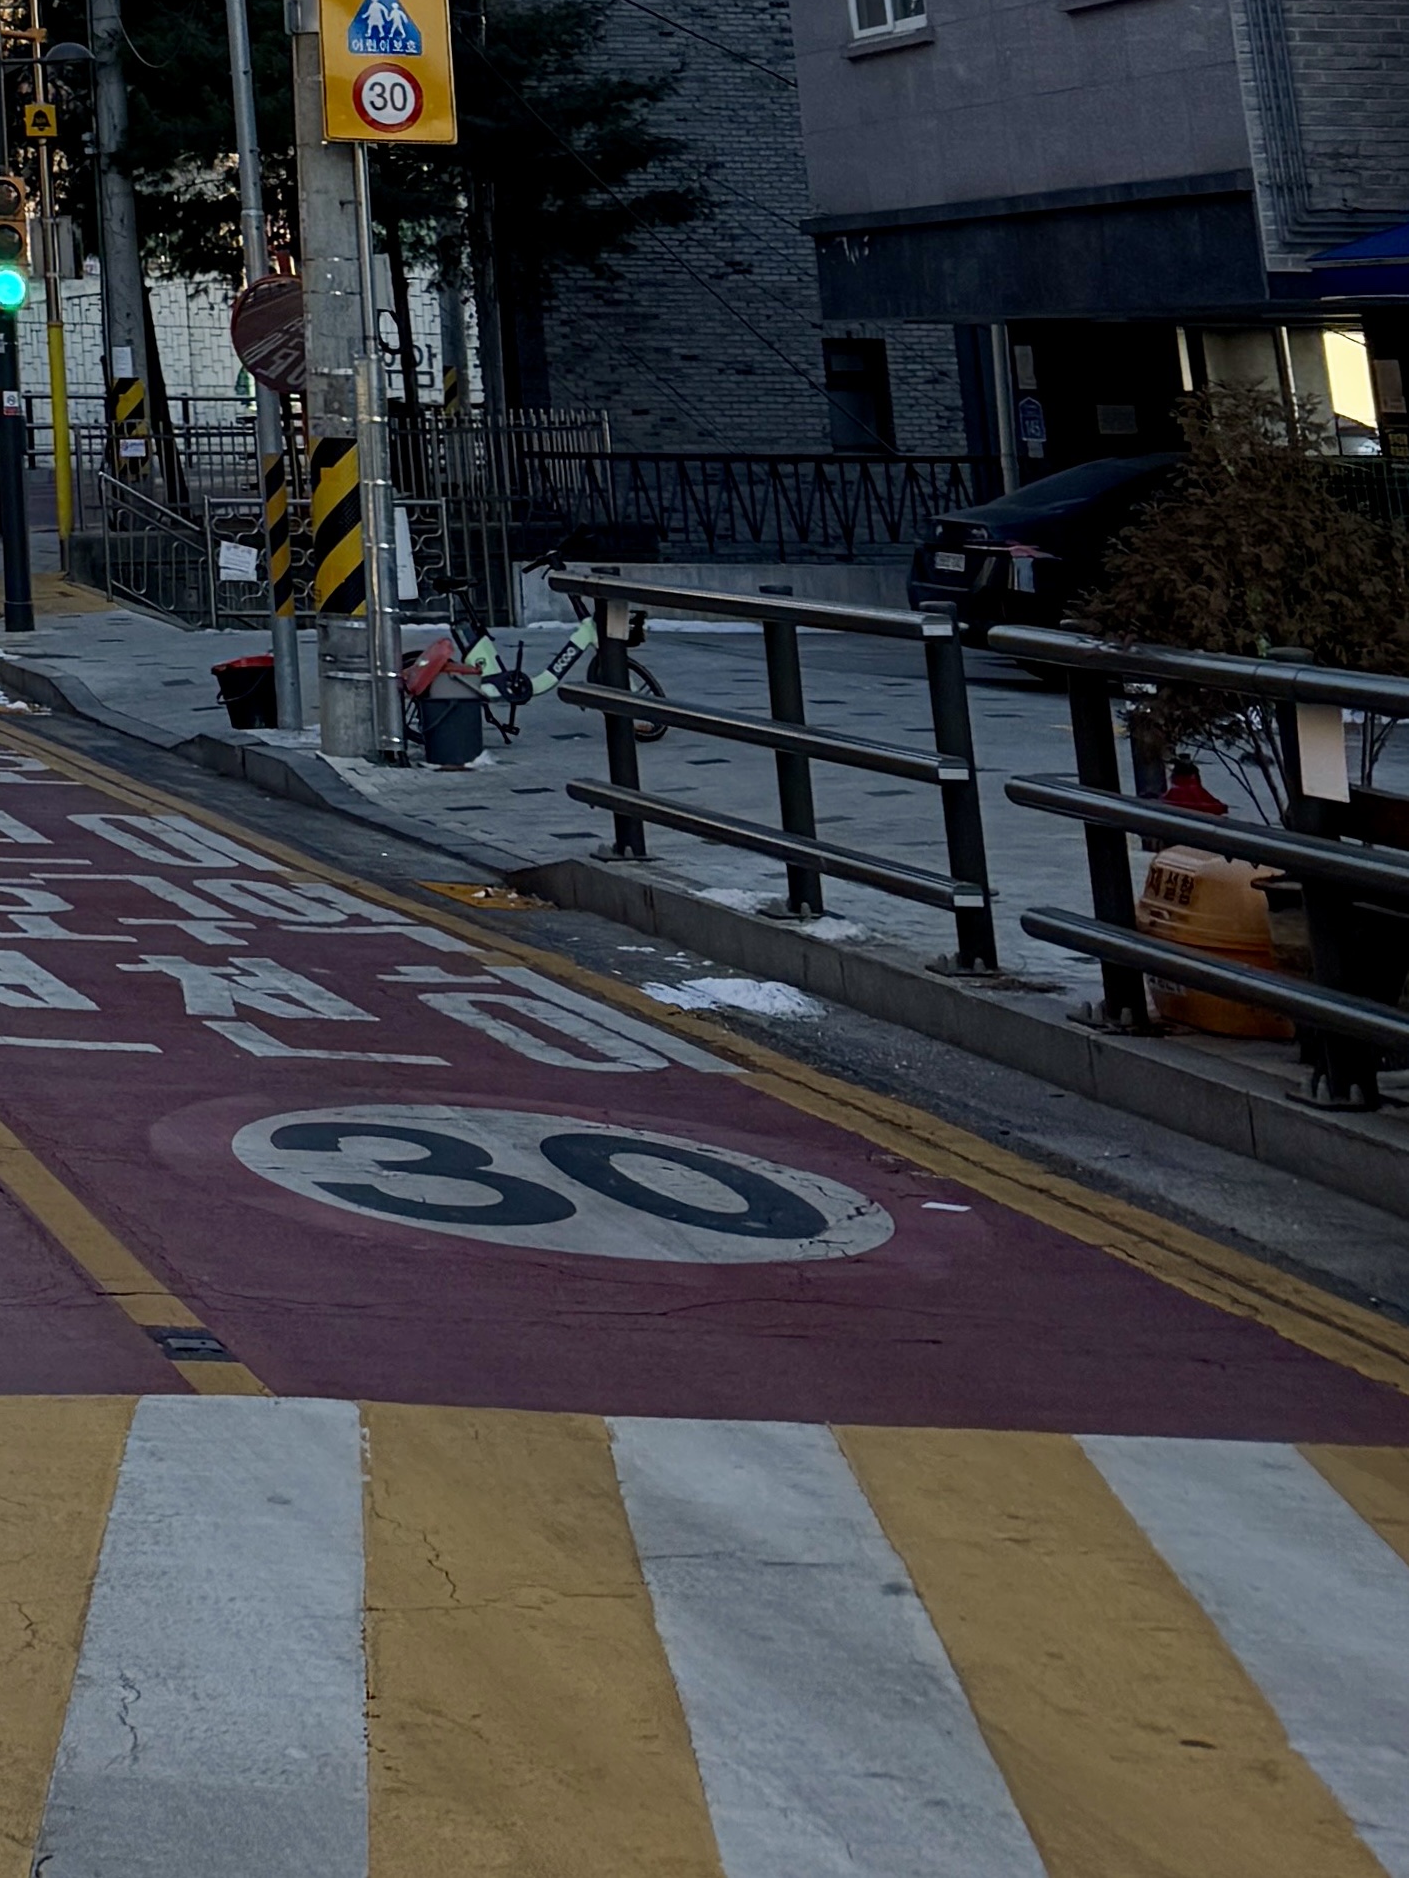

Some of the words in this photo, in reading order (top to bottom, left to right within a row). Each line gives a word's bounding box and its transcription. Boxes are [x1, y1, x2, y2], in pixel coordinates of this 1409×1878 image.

[351, 38, 418, 54] 어린이보호
[368, 81, 408, 112] 30
[1146, 866, 1195, 906] 제설함
[267, 1117, 831, 1242] 30
